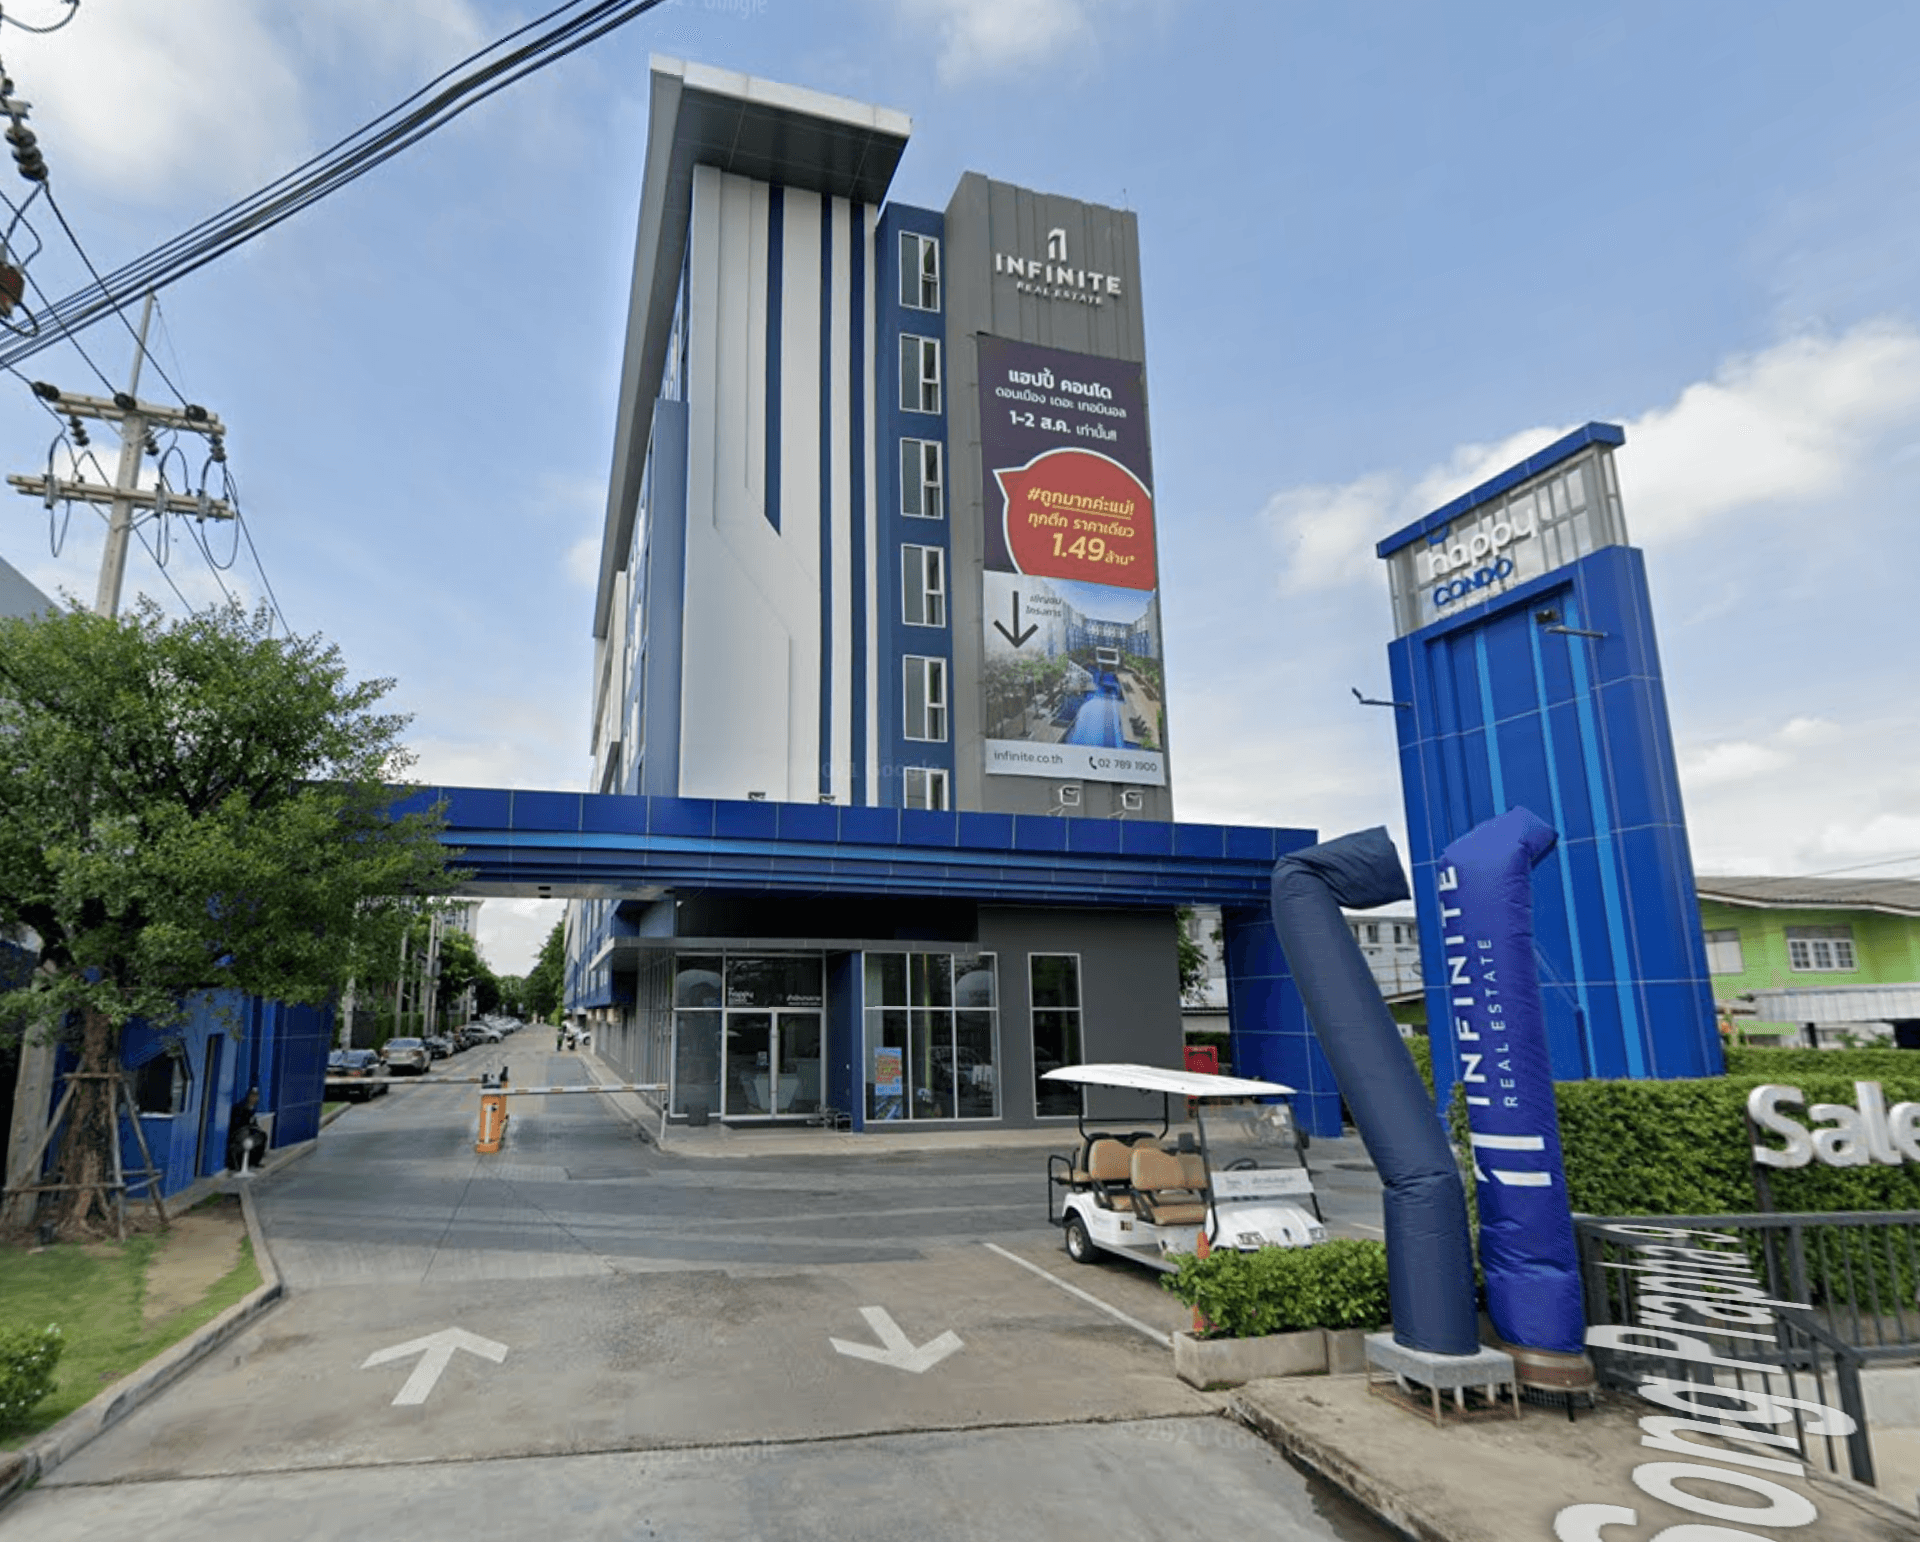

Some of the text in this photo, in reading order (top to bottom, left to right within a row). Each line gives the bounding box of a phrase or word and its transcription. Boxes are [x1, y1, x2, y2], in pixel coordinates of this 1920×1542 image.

[995, 252, 1122, 294] INFINITE
[1016, 280, 1104, 306] REAL ESTATE
[995, 386, 1047, 405] ดอนเมือง
[1060, 379, 1113, 400] คอนโด
[1009, 410, 1035, 428] 1-2
[1040, 416, 1071, 434] ส.ค.
[1073, 518, 1136, 538] ราคาเดียว
[1052, 532, 1106, 562] 1.49
[1428, 506, 1541, 580] happy
[1432, 557, 1514, 607] CONDO
[1097, 757, 1158, 773] 02 789 1900
[1437, 865, 1491, 1107] INFINITE
[1476, 938, 1519, 1109] REAL ESTATE
